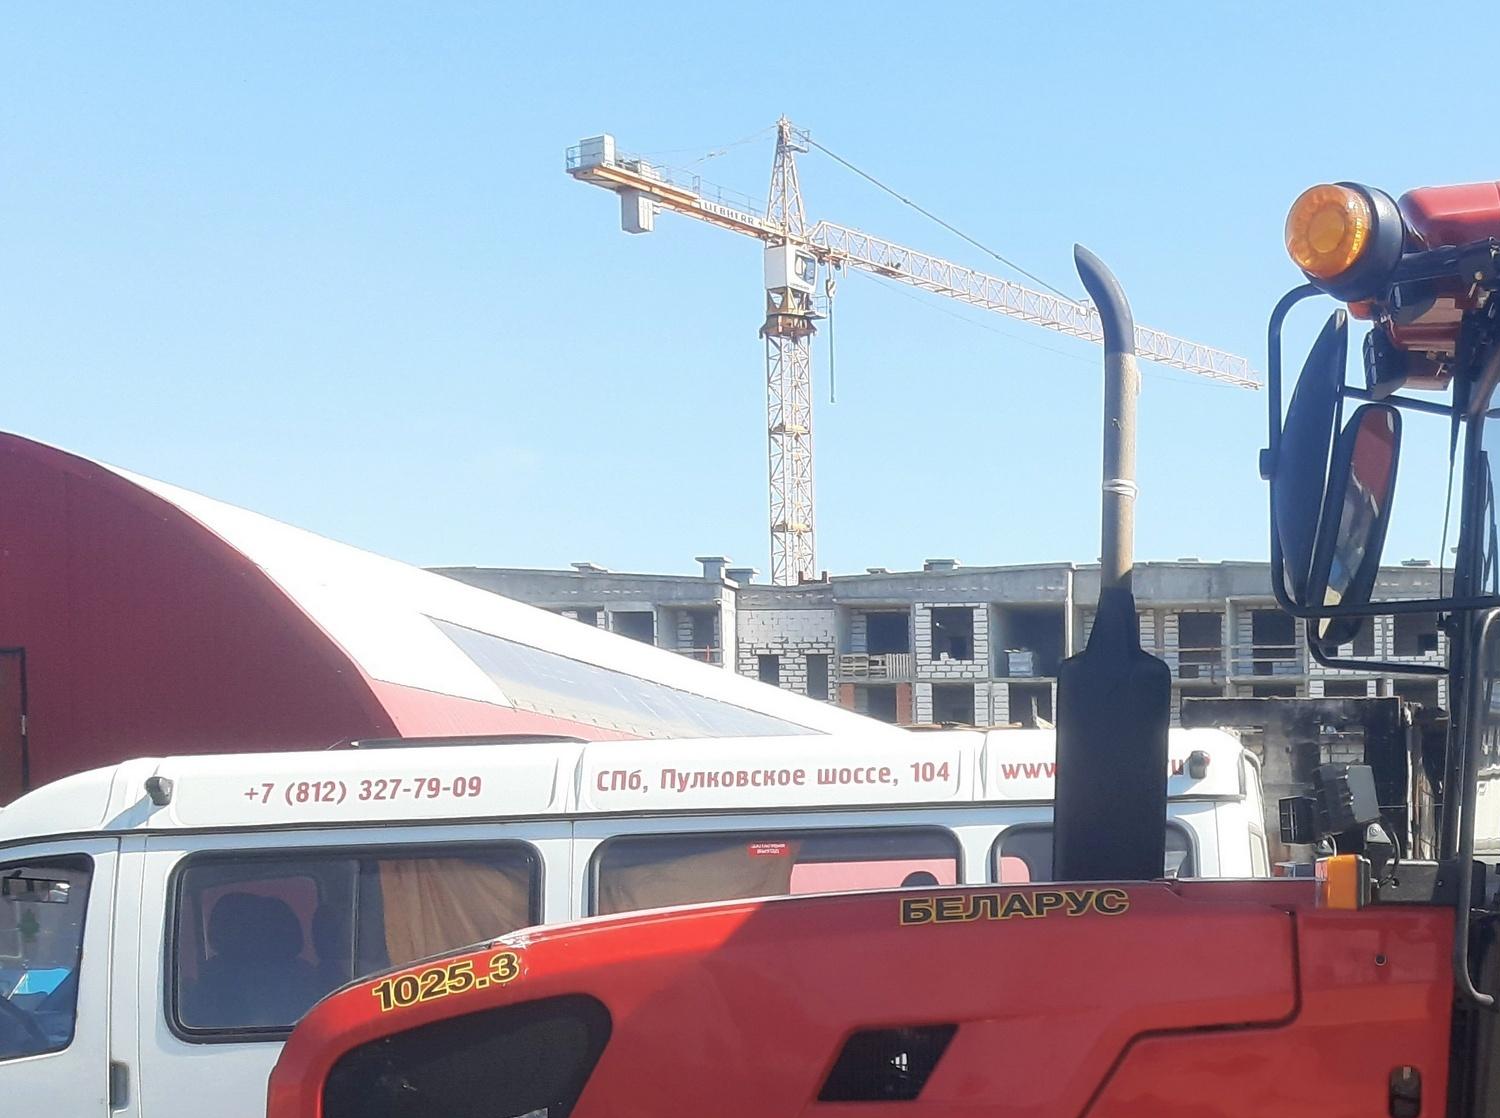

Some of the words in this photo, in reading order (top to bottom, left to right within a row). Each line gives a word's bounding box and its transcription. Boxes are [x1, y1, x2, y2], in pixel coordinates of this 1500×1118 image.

[704, 201, 754, 225] LIEBHERR
[244, 783, 275, 804] +7
[285, 780, 347, 806] (812)
[358, 776, 482, 800] 327-79-09
[597, 769, 648, 793] СПб,
[660, 768, 806, 792] Пулковское
[817, 766, 899, 786] шоссе,
[910, 762, 951, 782] 104
[900, 888, 1130, 926] БЕЛАРУС
[372, 951, 520, 1012] 1025.3
